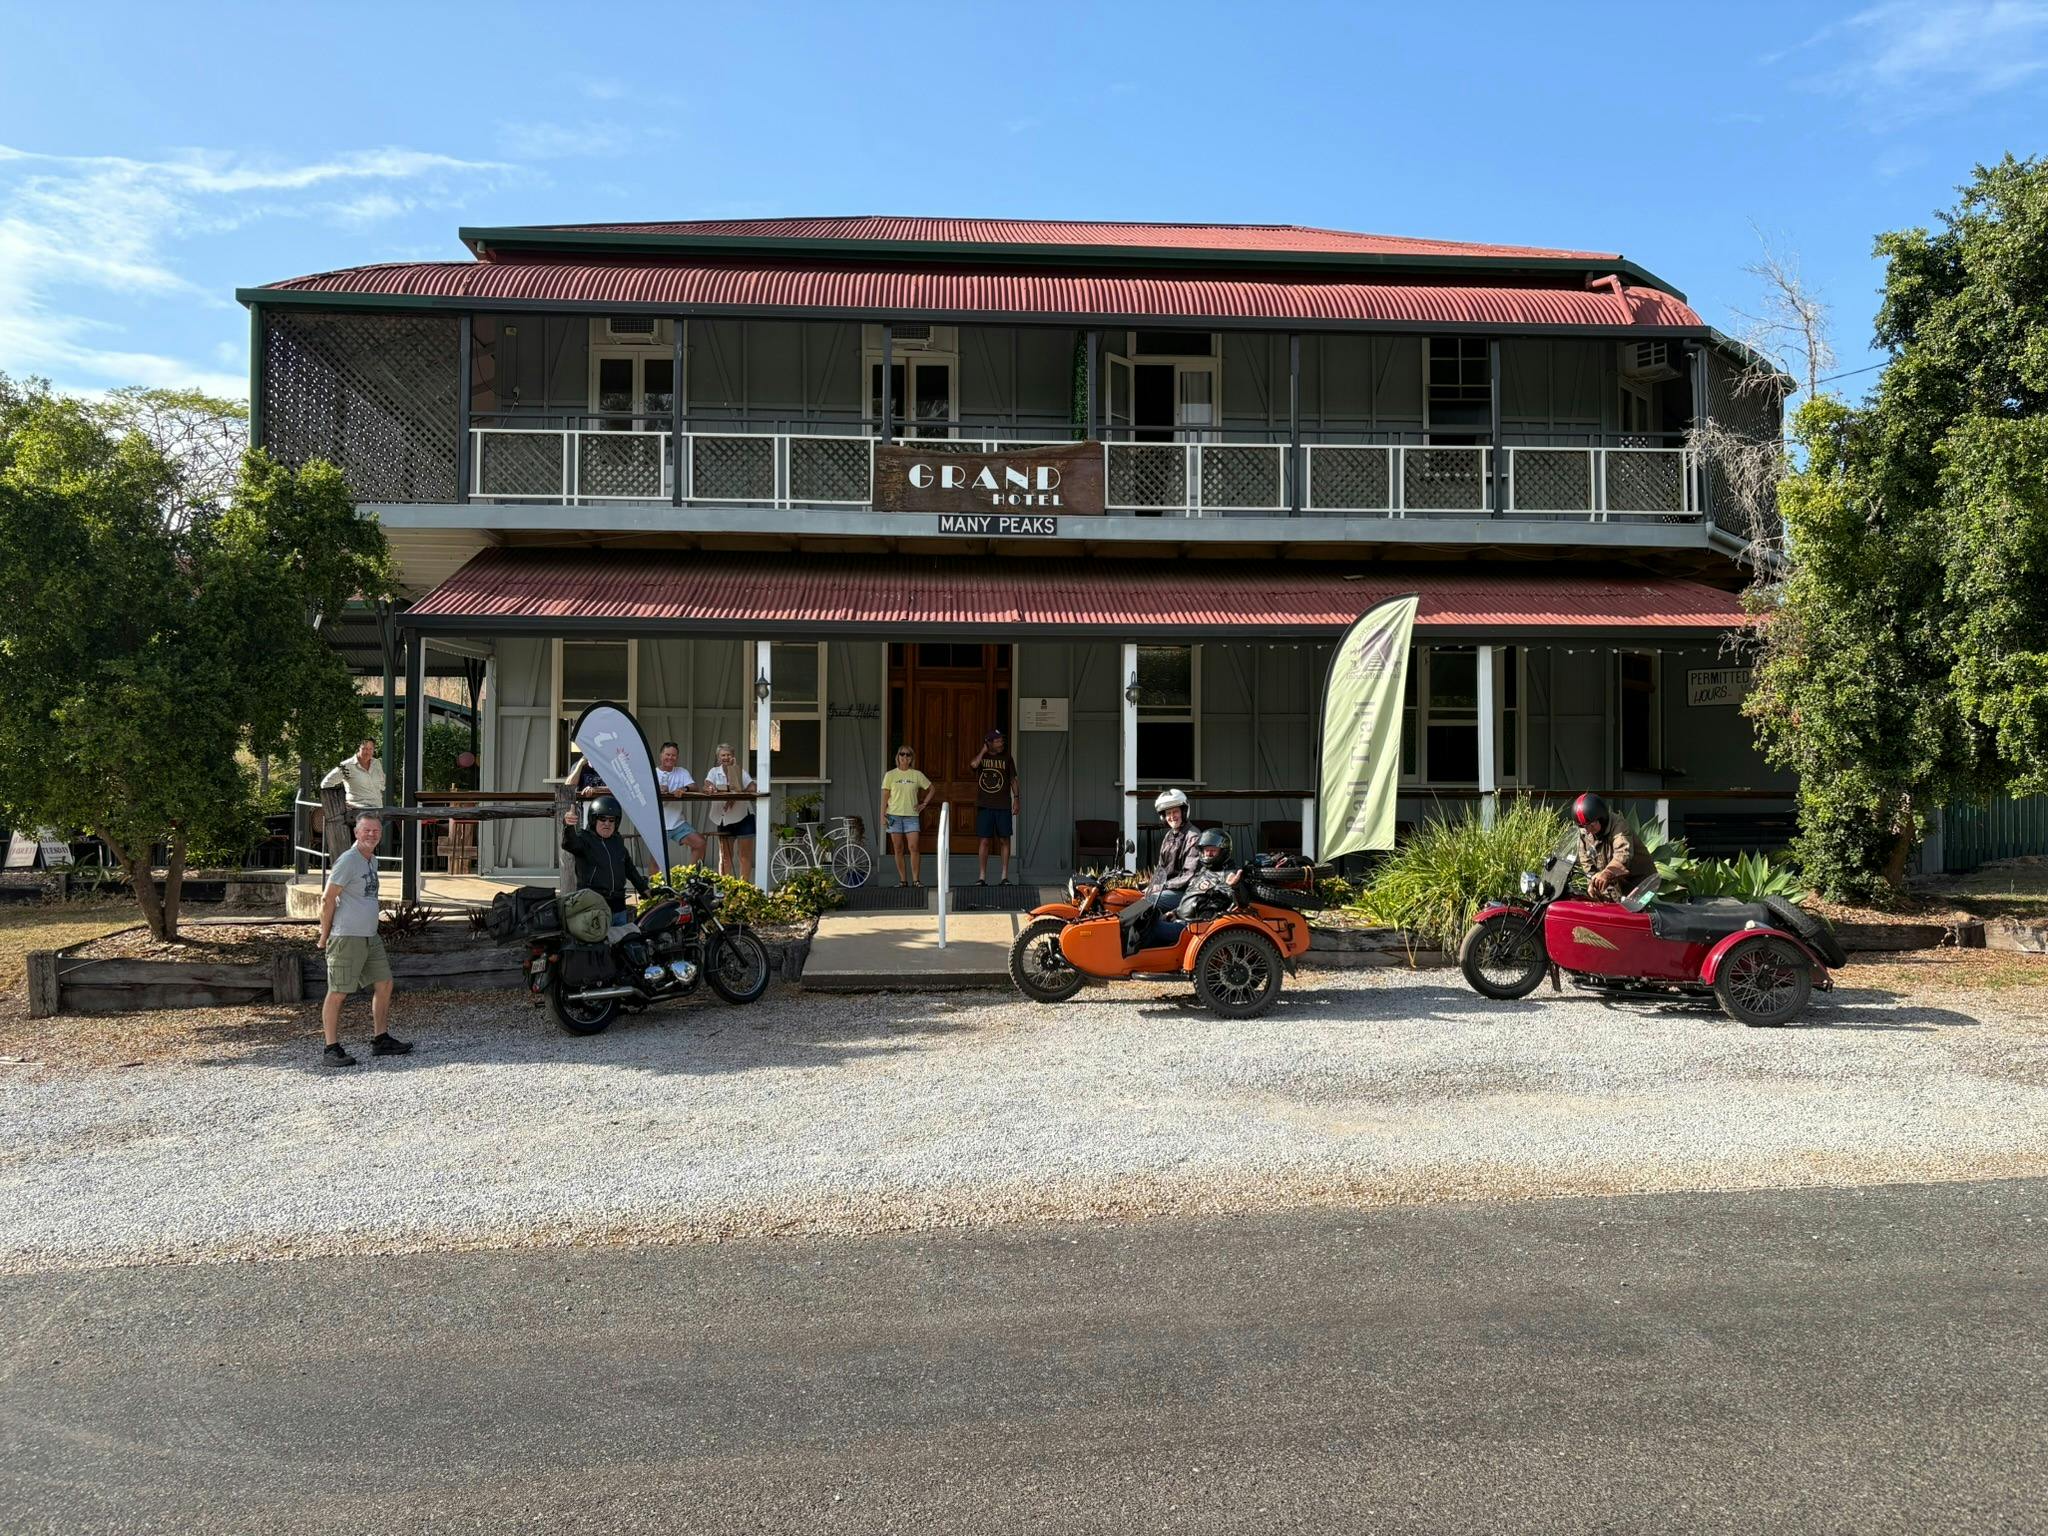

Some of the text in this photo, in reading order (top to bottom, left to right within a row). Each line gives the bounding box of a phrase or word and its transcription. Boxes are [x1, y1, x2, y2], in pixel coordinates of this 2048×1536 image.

[908, 464, 1061, 490] GRAND
[992, 494, 1064, 506] HOTEL
[941, 517, 1054, 533] MANY PEAKS
[1691, 671, 1750, 687] PERMITTED
[1694, 685, 1728, 704] HOURS
[1351, 701, 1375, 770] Trail
[1345, 780, 1369, 834] Rail
